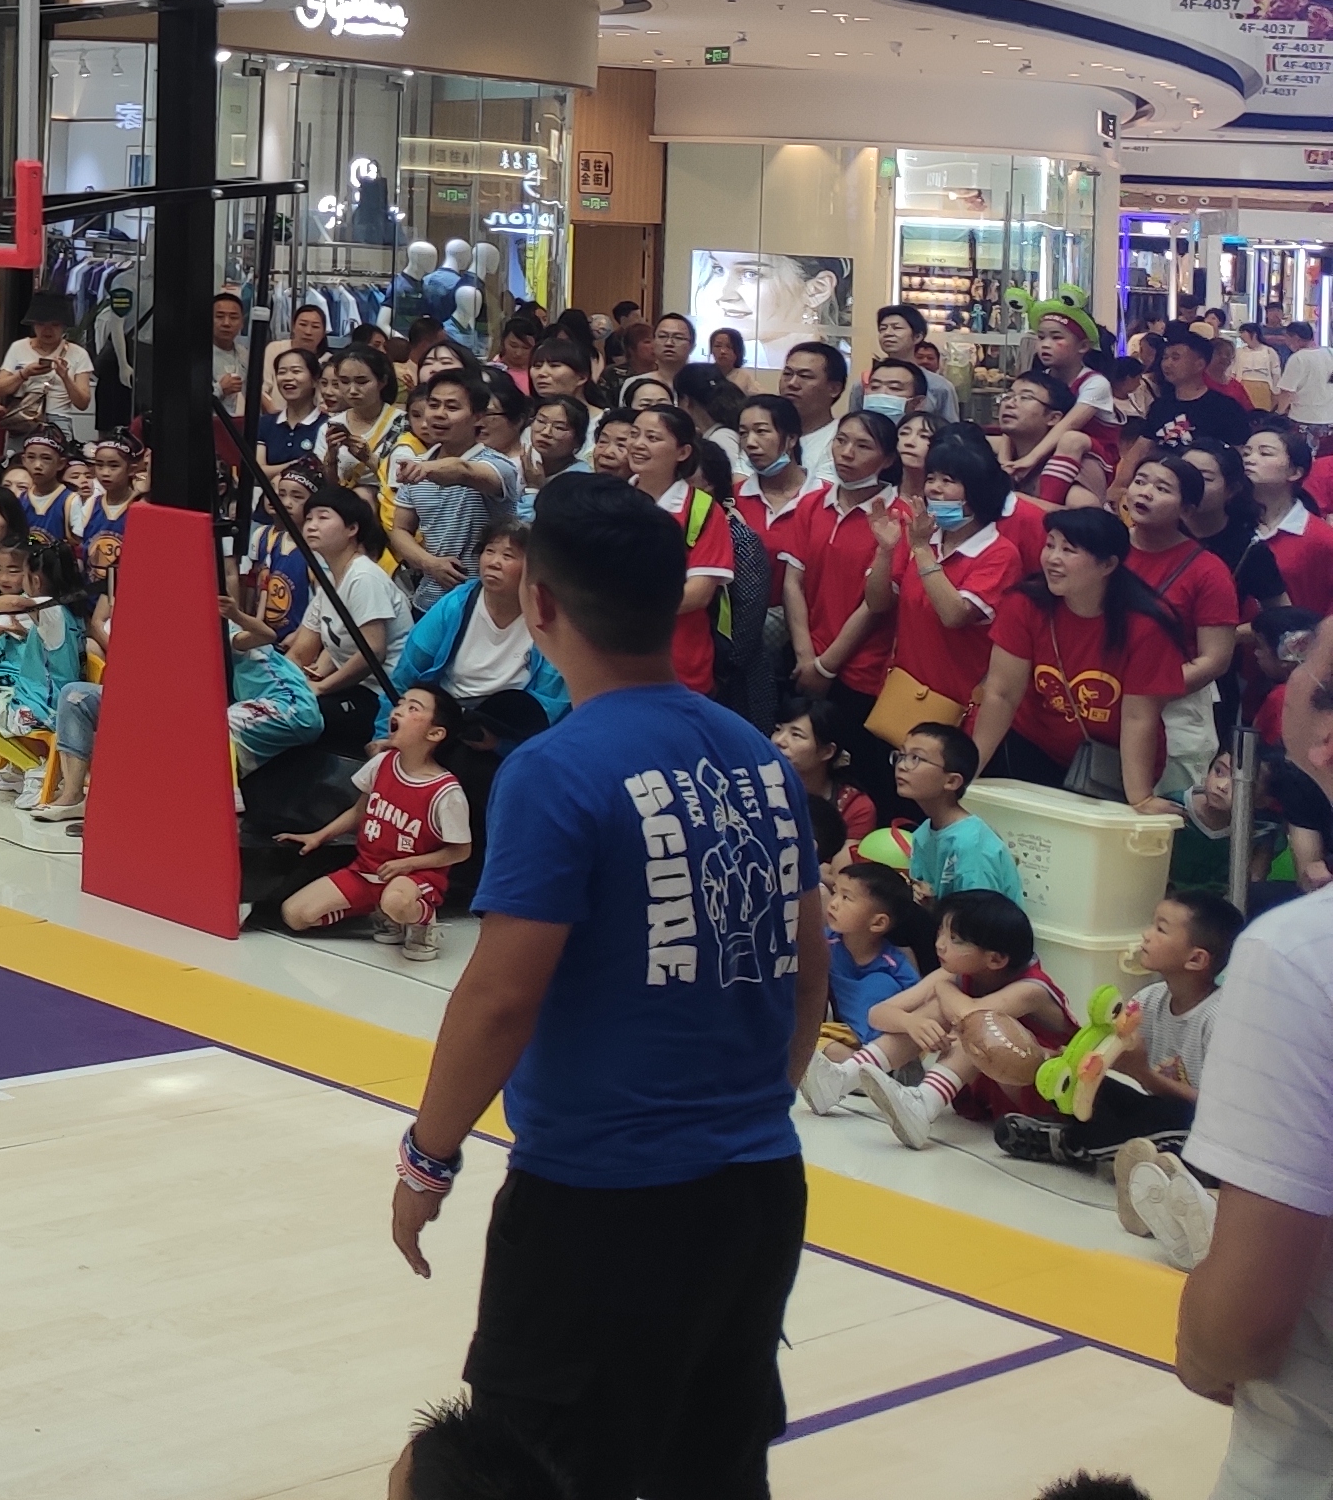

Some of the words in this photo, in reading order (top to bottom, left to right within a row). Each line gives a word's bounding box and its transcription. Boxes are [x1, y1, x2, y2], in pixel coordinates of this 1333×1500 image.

[1238, 23, 1295, 34] 4F-4037
[1272, 43, 1325, 53] 4F-4037
[1283, 61, 1332, 71] 4F-4037
[1259, 88, 1298, 96] F-4037
[271, 584, 285, 598] 30
[671, 769, 708, 829] ATTACK
[730, 767, 763, 821] FIRST
[365, 792, 422, 839] CHINA
[624, 769, 698, 986] SCORE
